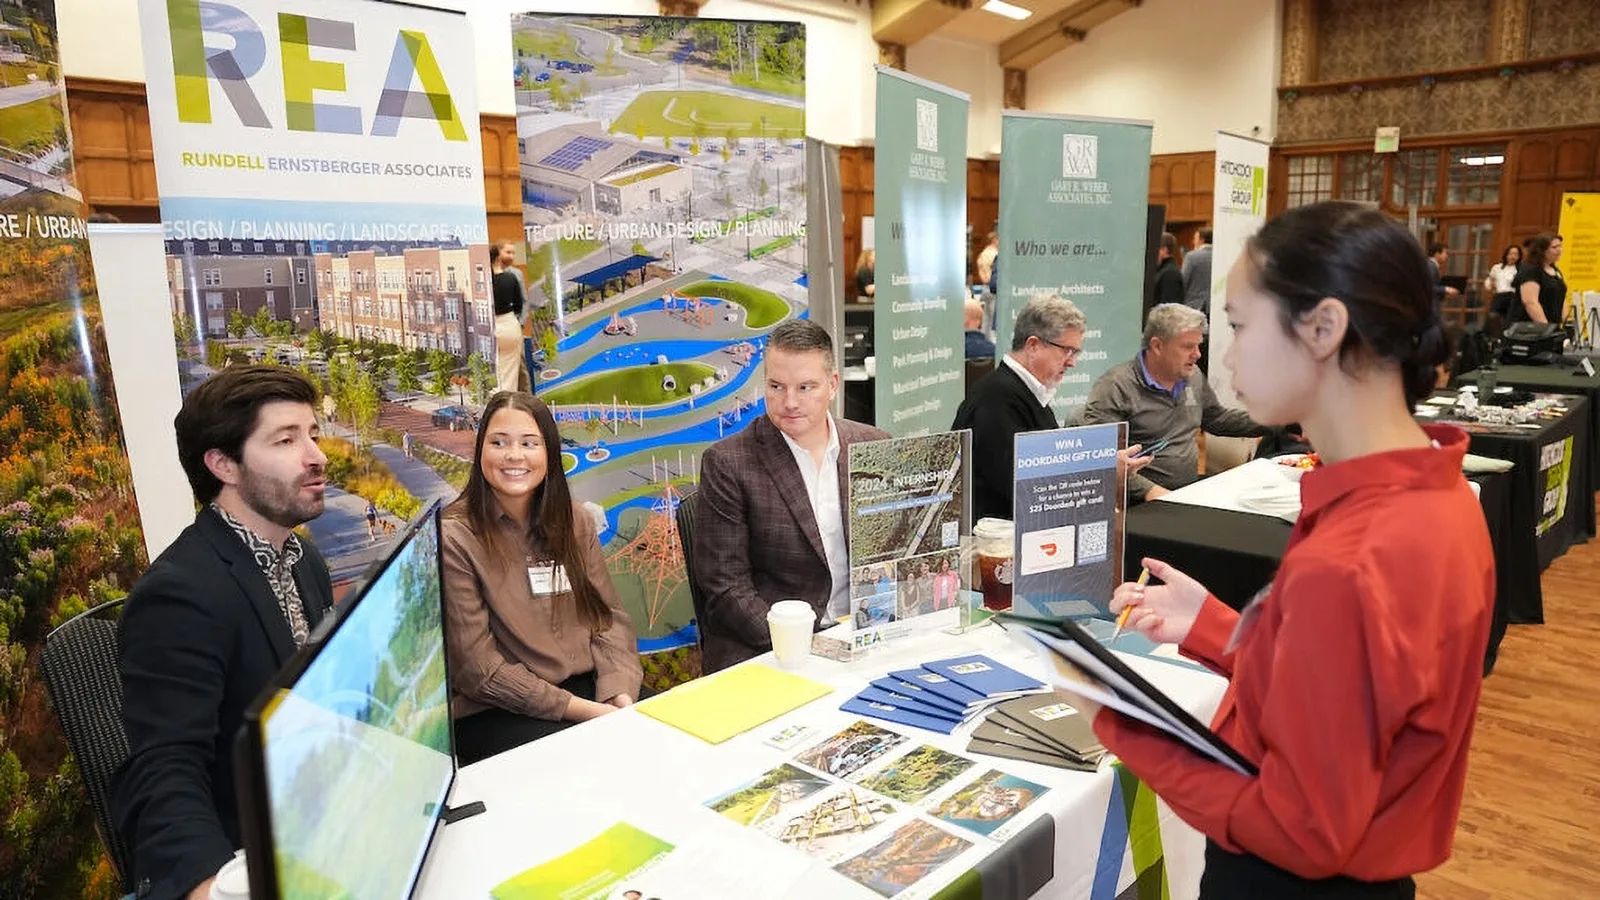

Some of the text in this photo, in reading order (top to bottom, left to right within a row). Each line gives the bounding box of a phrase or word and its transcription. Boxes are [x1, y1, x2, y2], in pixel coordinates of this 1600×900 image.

[166, 0, 468, 141] REA
[182, 151, 472, 179] RUNDELL ERNSTBERGER ASSOCIATES
[36, 215, 88, 239] URBAN
[241, 221, 336, 241] PLANNING
[608, 222, 662, 239] URBAN
[666, 221, 721, 239] DESIGN
[735, 218, 806, 237] PLANNING
[1015, 240, 1047, 256] Who
[1051, 243, 1069, 255] we
[1055, 438, 1083, 450] WIN A
[1018, 448, 1117, 469] DOORDASH GIFT CARD
[1029, 504, 1044, 514] $25
[1044, 500, 1076, 512] Doordash
[855, 632, 882, 648] REA
